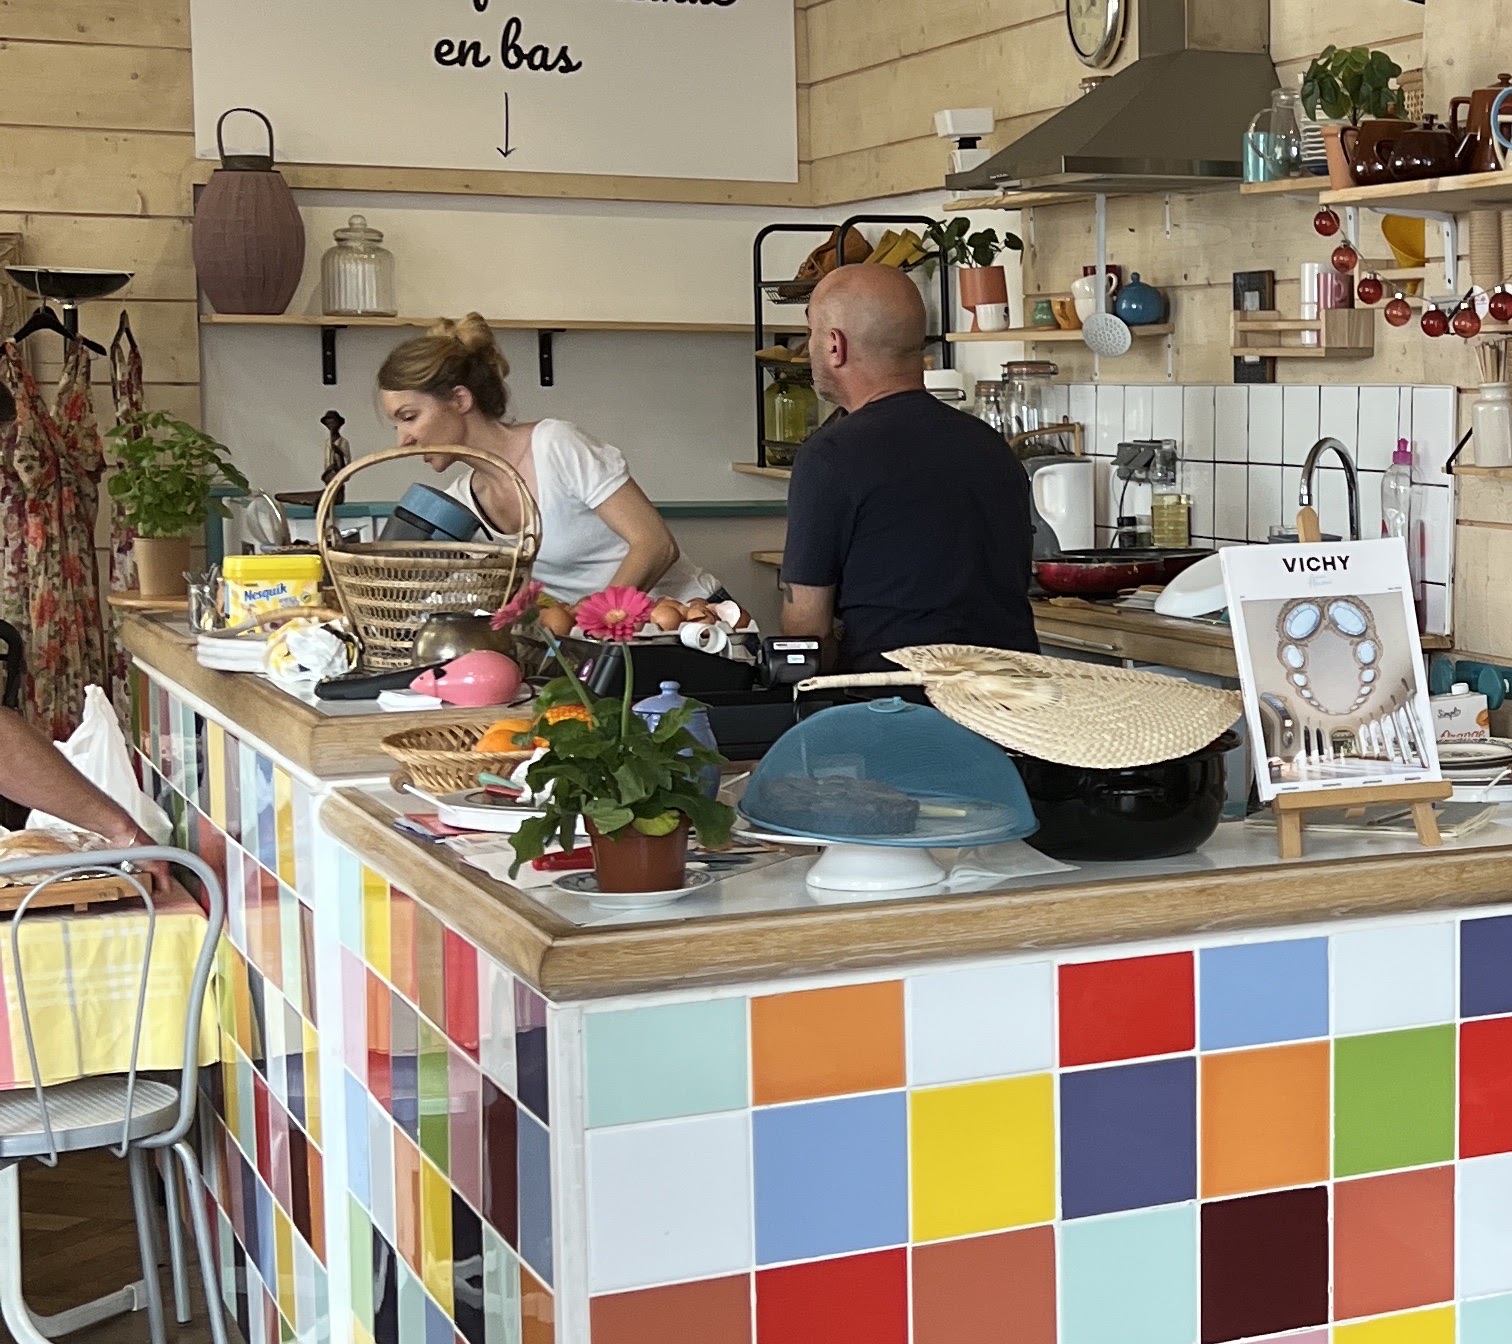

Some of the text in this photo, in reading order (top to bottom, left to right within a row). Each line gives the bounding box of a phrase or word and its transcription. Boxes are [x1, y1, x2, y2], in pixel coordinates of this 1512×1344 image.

[433, 17, 583, 74] en bas
[1282, 555, 1350, 573] VICHY
[244, 583, 288, 601] Nesquik
